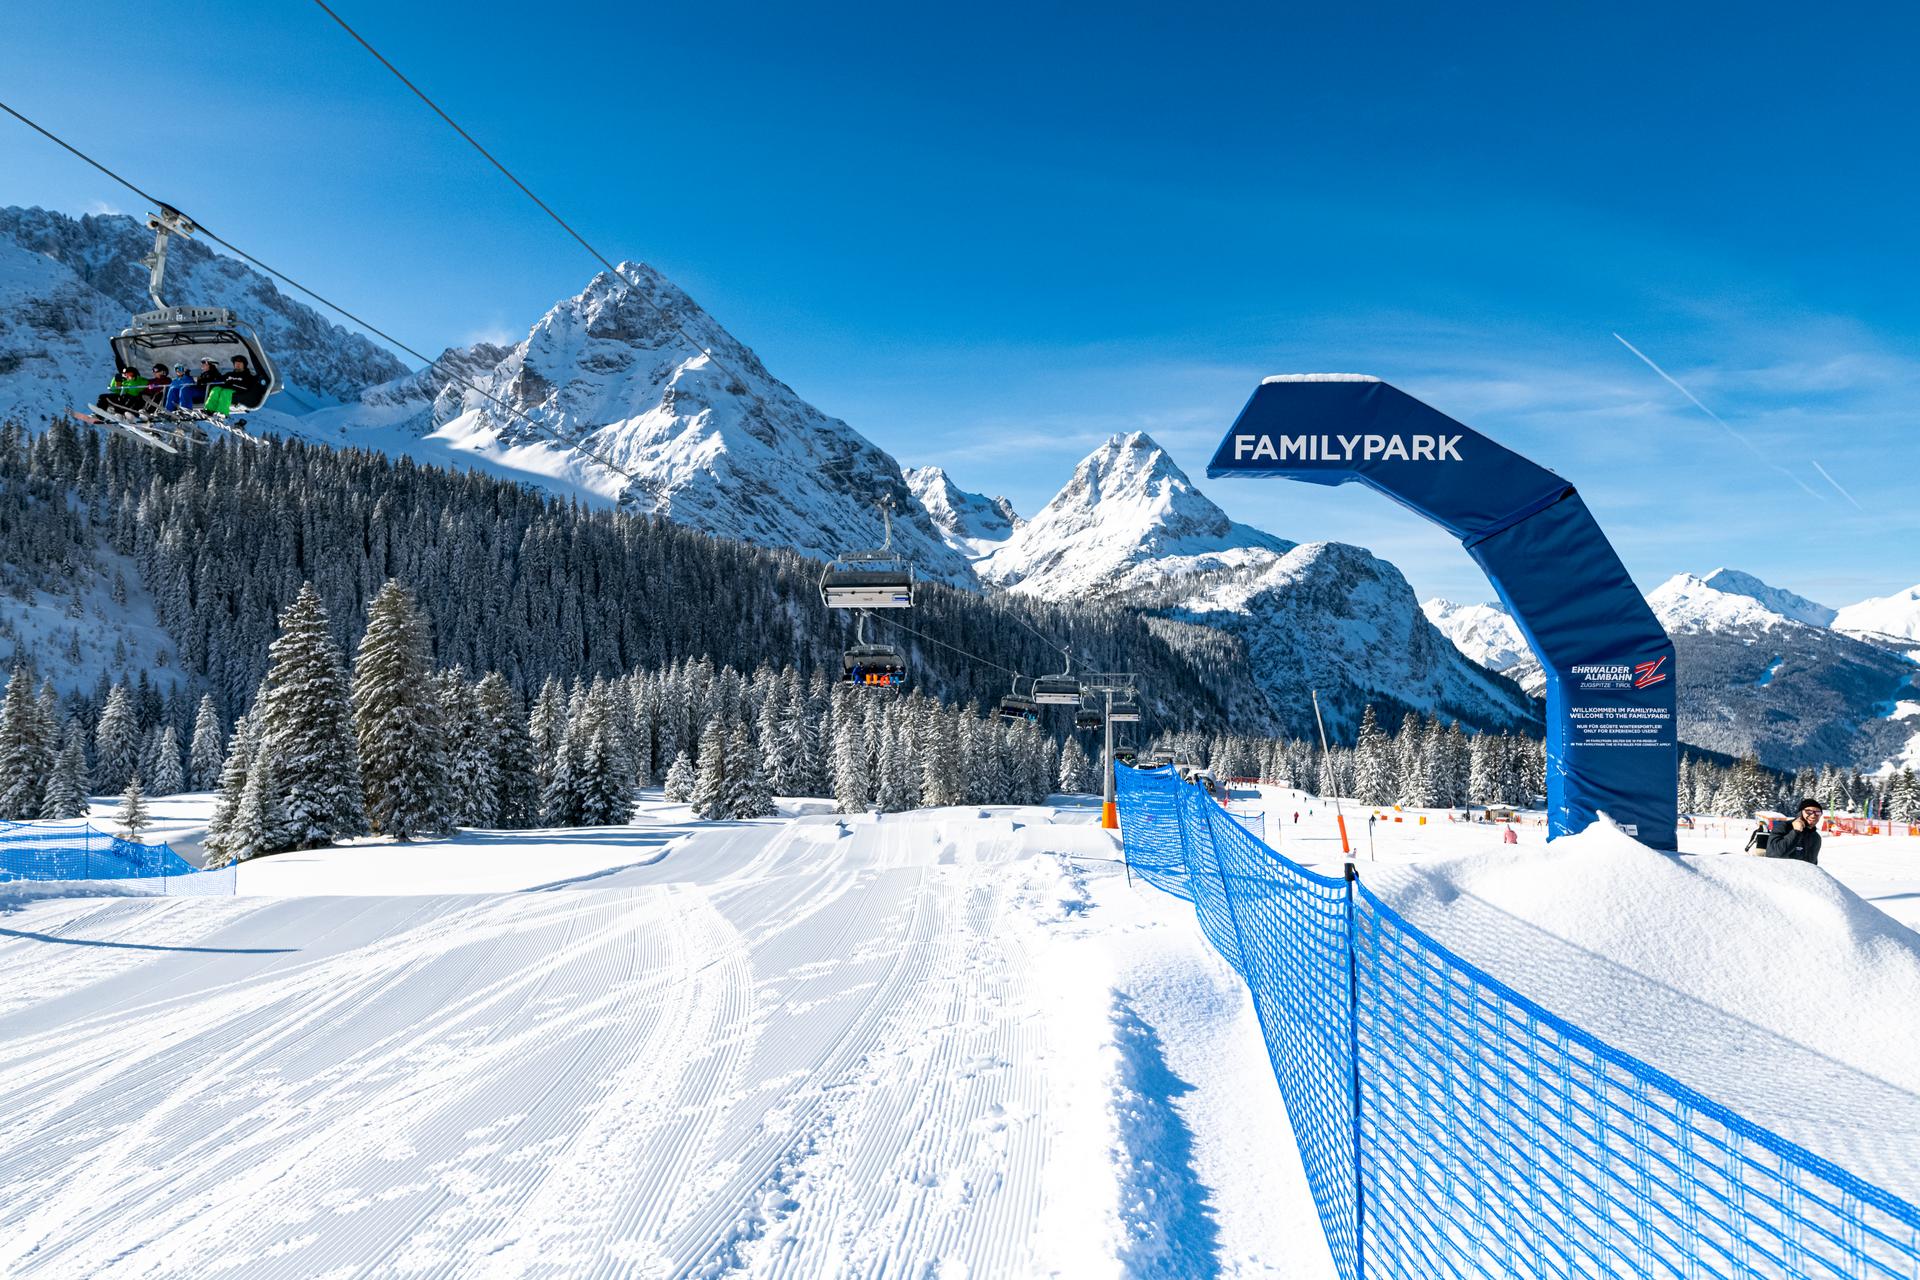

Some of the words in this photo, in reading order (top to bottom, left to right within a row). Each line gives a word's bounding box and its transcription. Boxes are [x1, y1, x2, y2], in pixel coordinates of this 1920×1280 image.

[1234, 434, 1464, 461] FAMILYPARK
[1571, 666, 1630, 674] EHRWALDER
[1584, 673, 1633, 681] ALMBAHN
